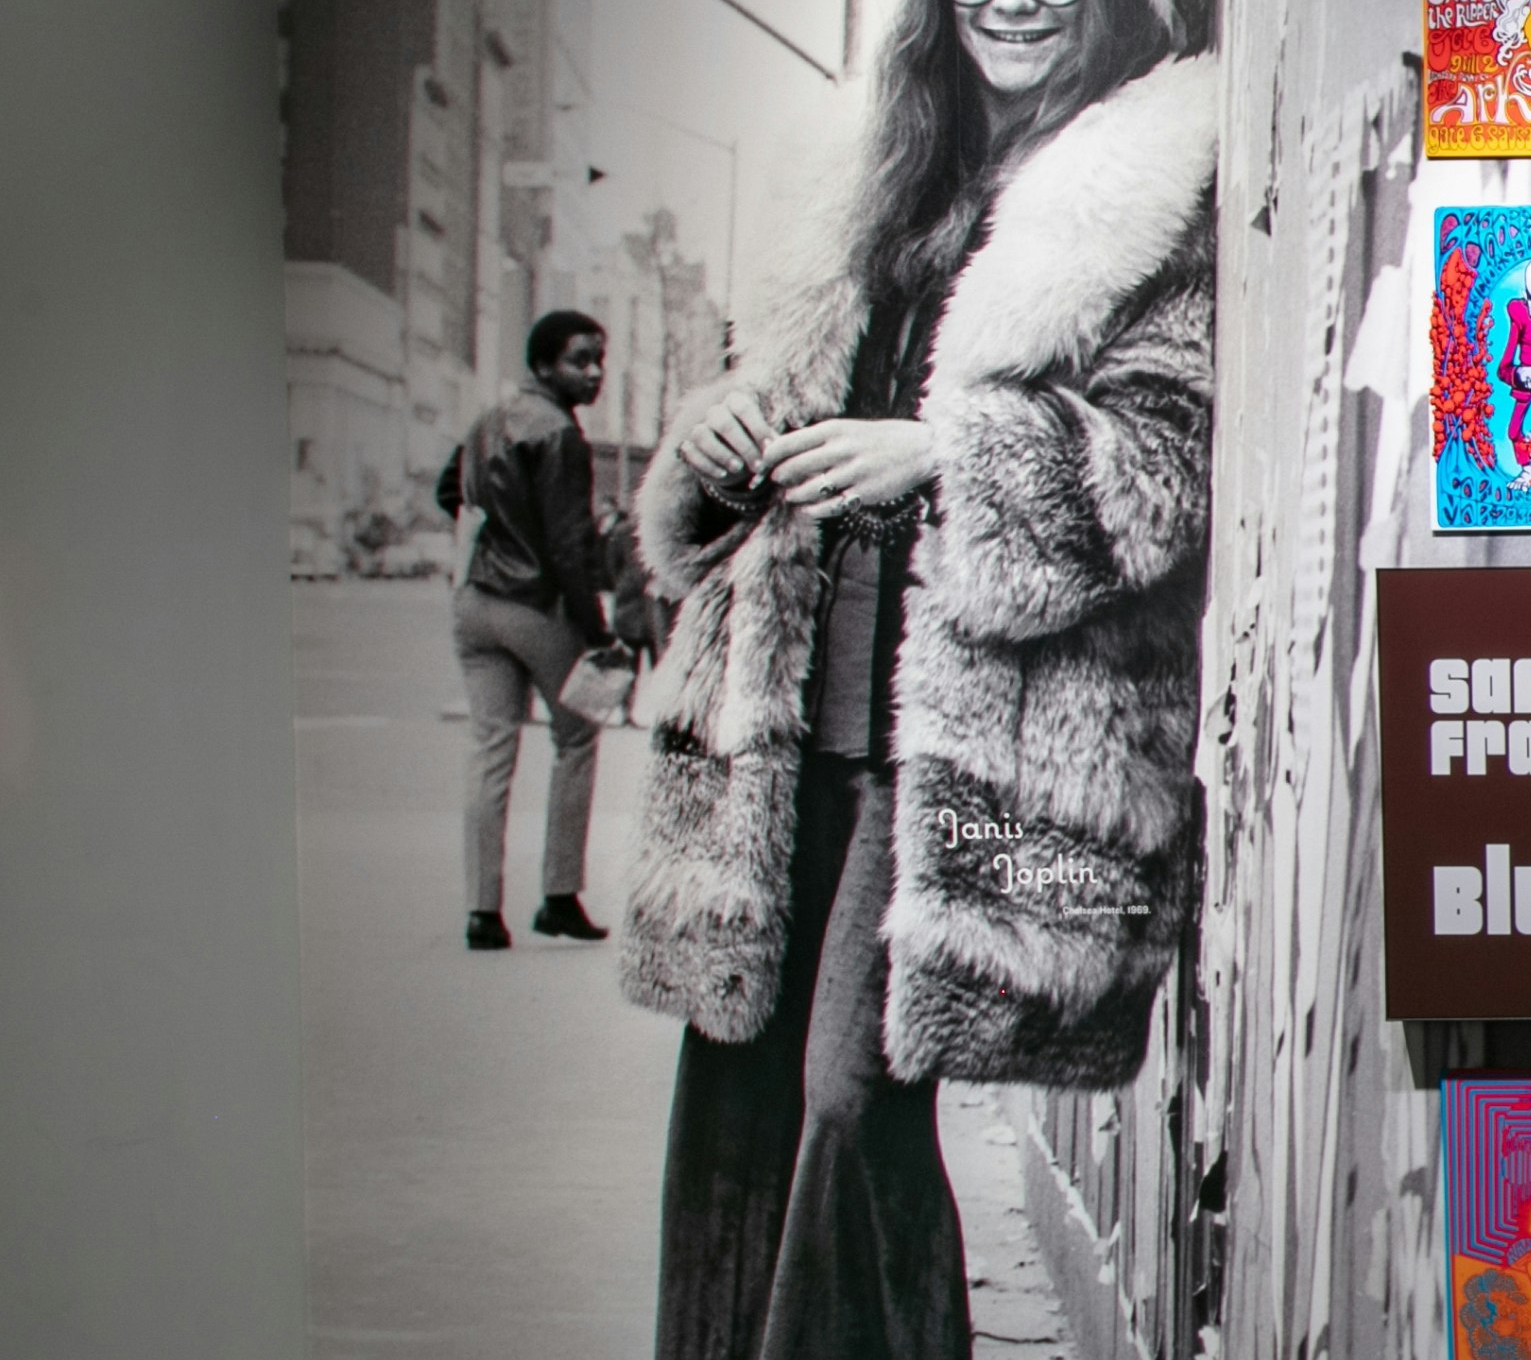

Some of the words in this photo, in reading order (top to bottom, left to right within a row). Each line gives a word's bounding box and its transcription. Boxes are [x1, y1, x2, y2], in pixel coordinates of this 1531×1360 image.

[938, 808, 1024, 849] Janis
[993, 853, 1098, 894] Joplin
[1062, 906, 1098, 915] Chelsea
